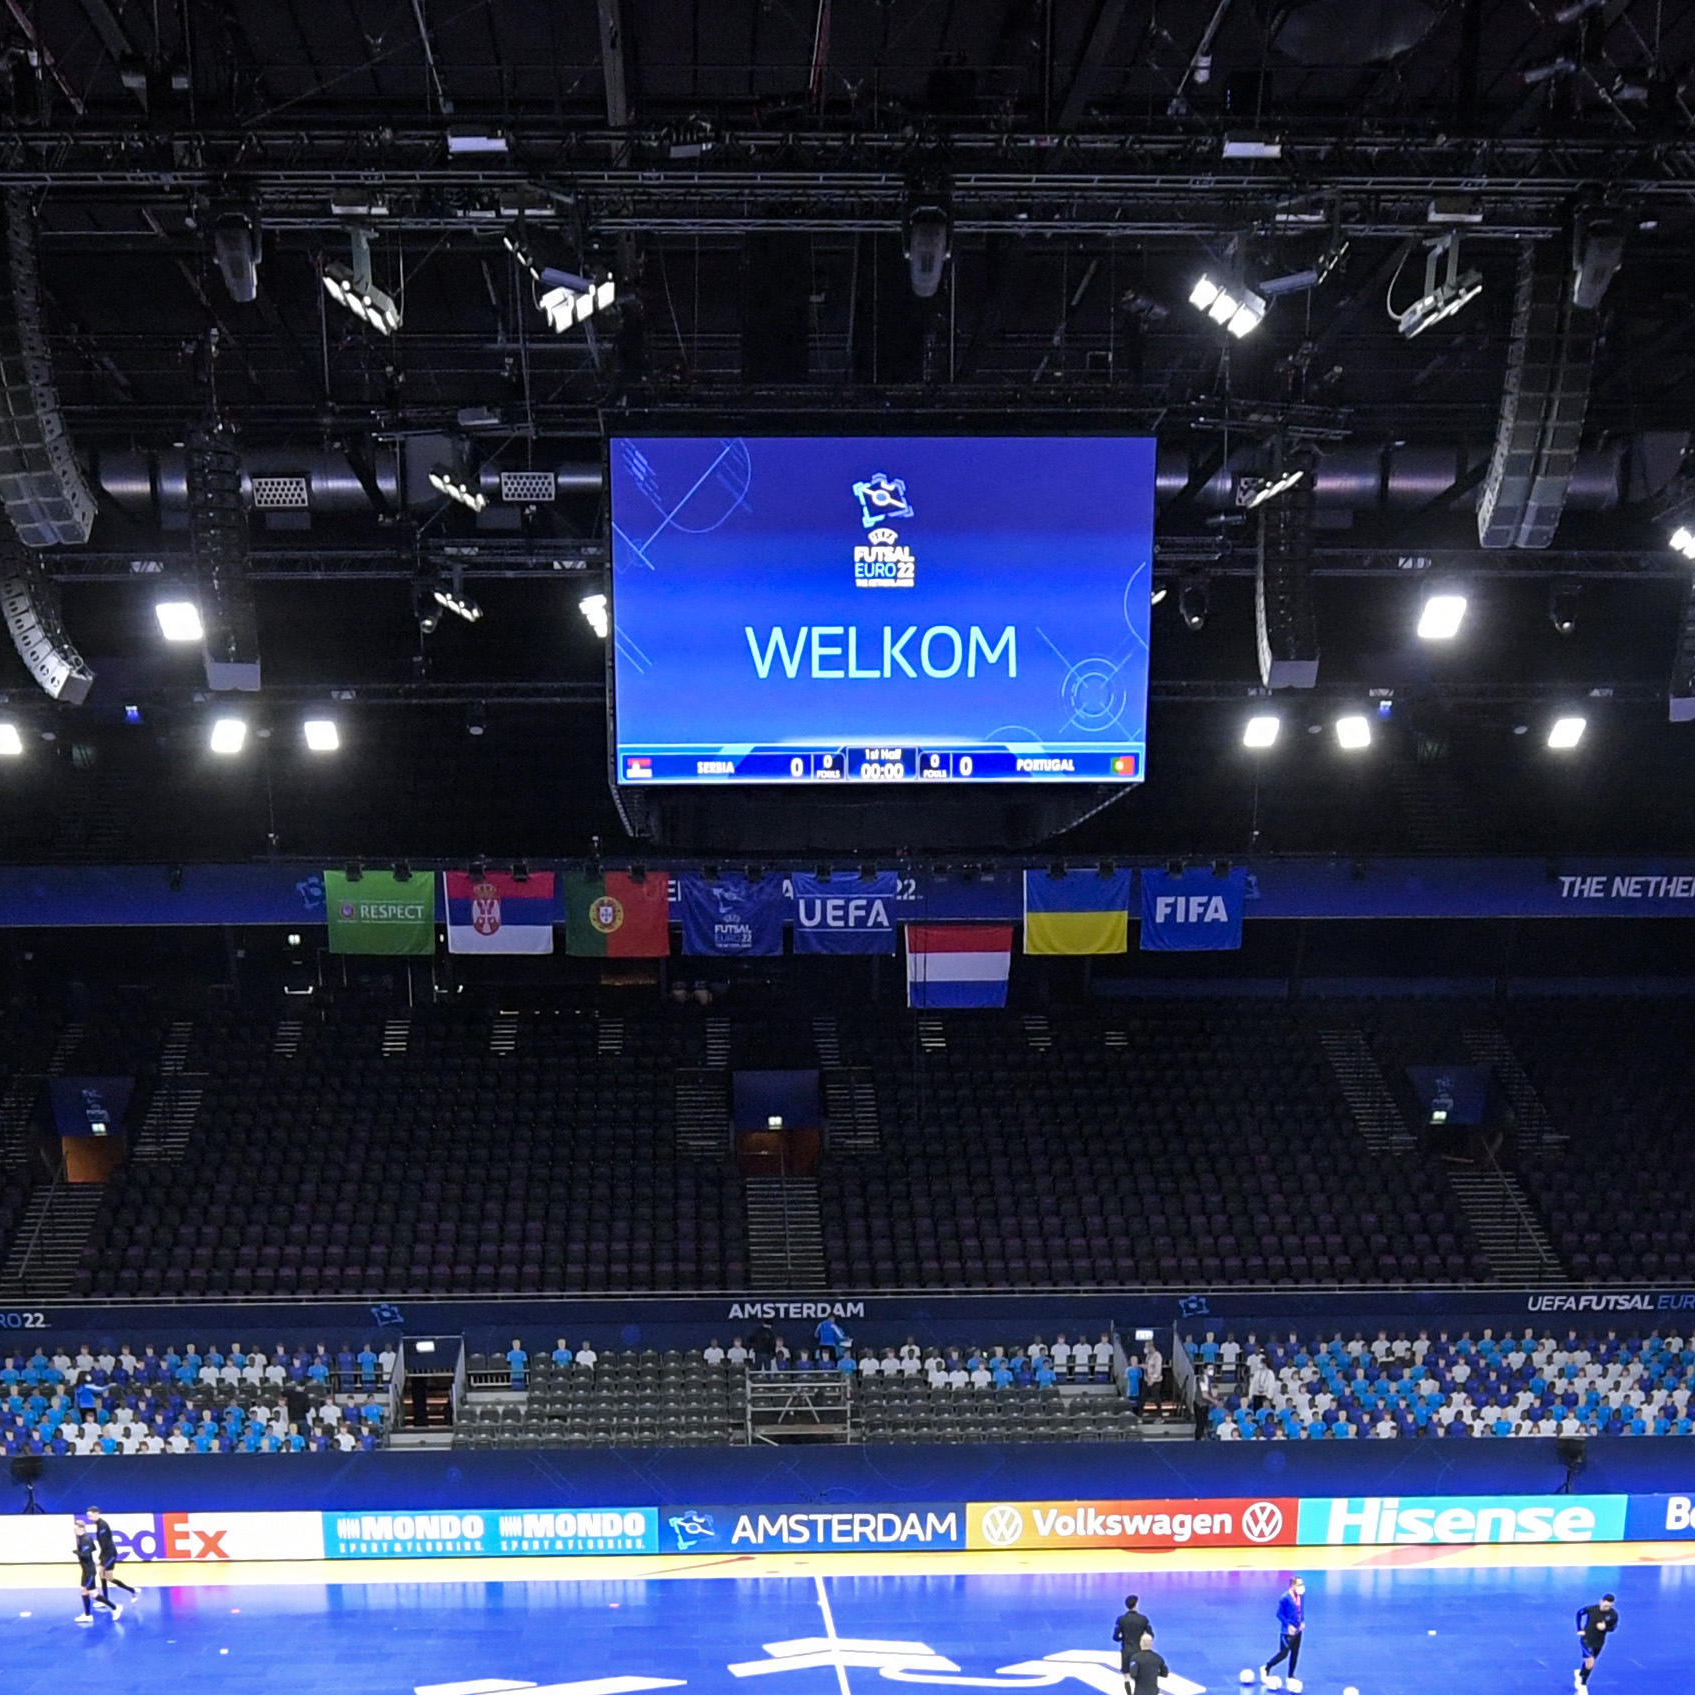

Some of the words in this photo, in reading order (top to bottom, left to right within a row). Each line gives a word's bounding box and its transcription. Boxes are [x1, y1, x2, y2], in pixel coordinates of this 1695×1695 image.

[854, 546, 915, 562] FUTSAL
[745, 625, 1018, 679] WELKOM
[697, 761, 735, 774] SERBIA
[790, 757, 804, 777] 0
[823, 754, 833, 768] 0
[861, 763, 904, 779] 00:00
[930, 754, 940, 768] 0
[959, 756, 973, 776] 0
[1016, 758, 1075, 772] PORTUGAL
[1559, 876, 1606, 897] THE
[361, 904, 424, 919] RESPECT
[799, 898, 889, 927] UEFA
[1155, 896, 1229, 923] FIFA
[714, 924, 752, 934] FUTSAL
[728, 1302, 864, 1319] AMSTERDAM
[1527, 1296, 1576, 1312] UEFA
[1578, 1295, 1654, 1311] FUTSAL
[361, 1515, 484, 1540] MONDO
[523, 1512, 645, 1538] MONDO
[731, 1511, 957, 1545] AMSTERDAM
[1033, 1506, 1232, 1540] Volkswagen
[1327, 1498, 1596, 1543] Hisense
